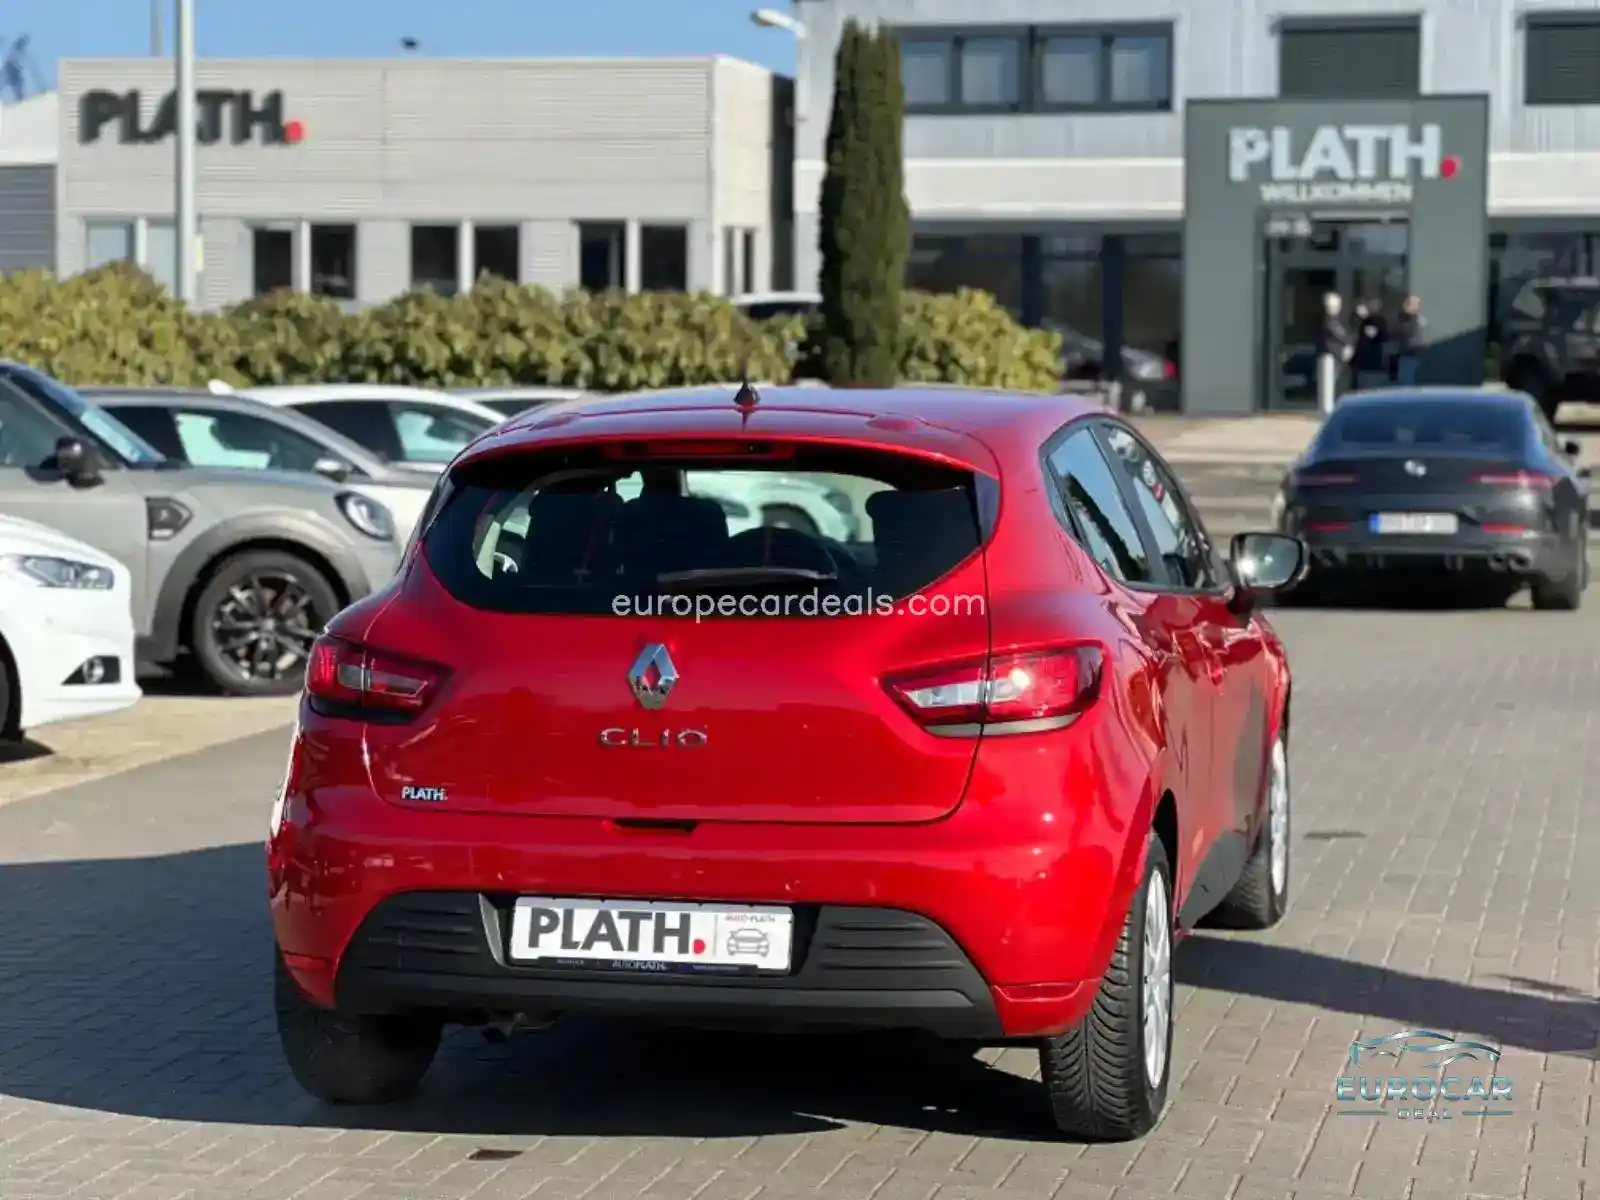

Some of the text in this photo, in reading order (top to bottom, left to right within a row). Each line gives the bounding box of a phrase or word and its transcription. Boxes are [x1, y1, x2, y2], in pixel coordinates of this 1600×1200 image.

[1228, 123, 1461, 182] PLATH.
[1259, 183, 1414, 202] WILLKOMMEN
[599, 727, 709, 748] CLIO
[528, 907, 706, 955] PLATH.
